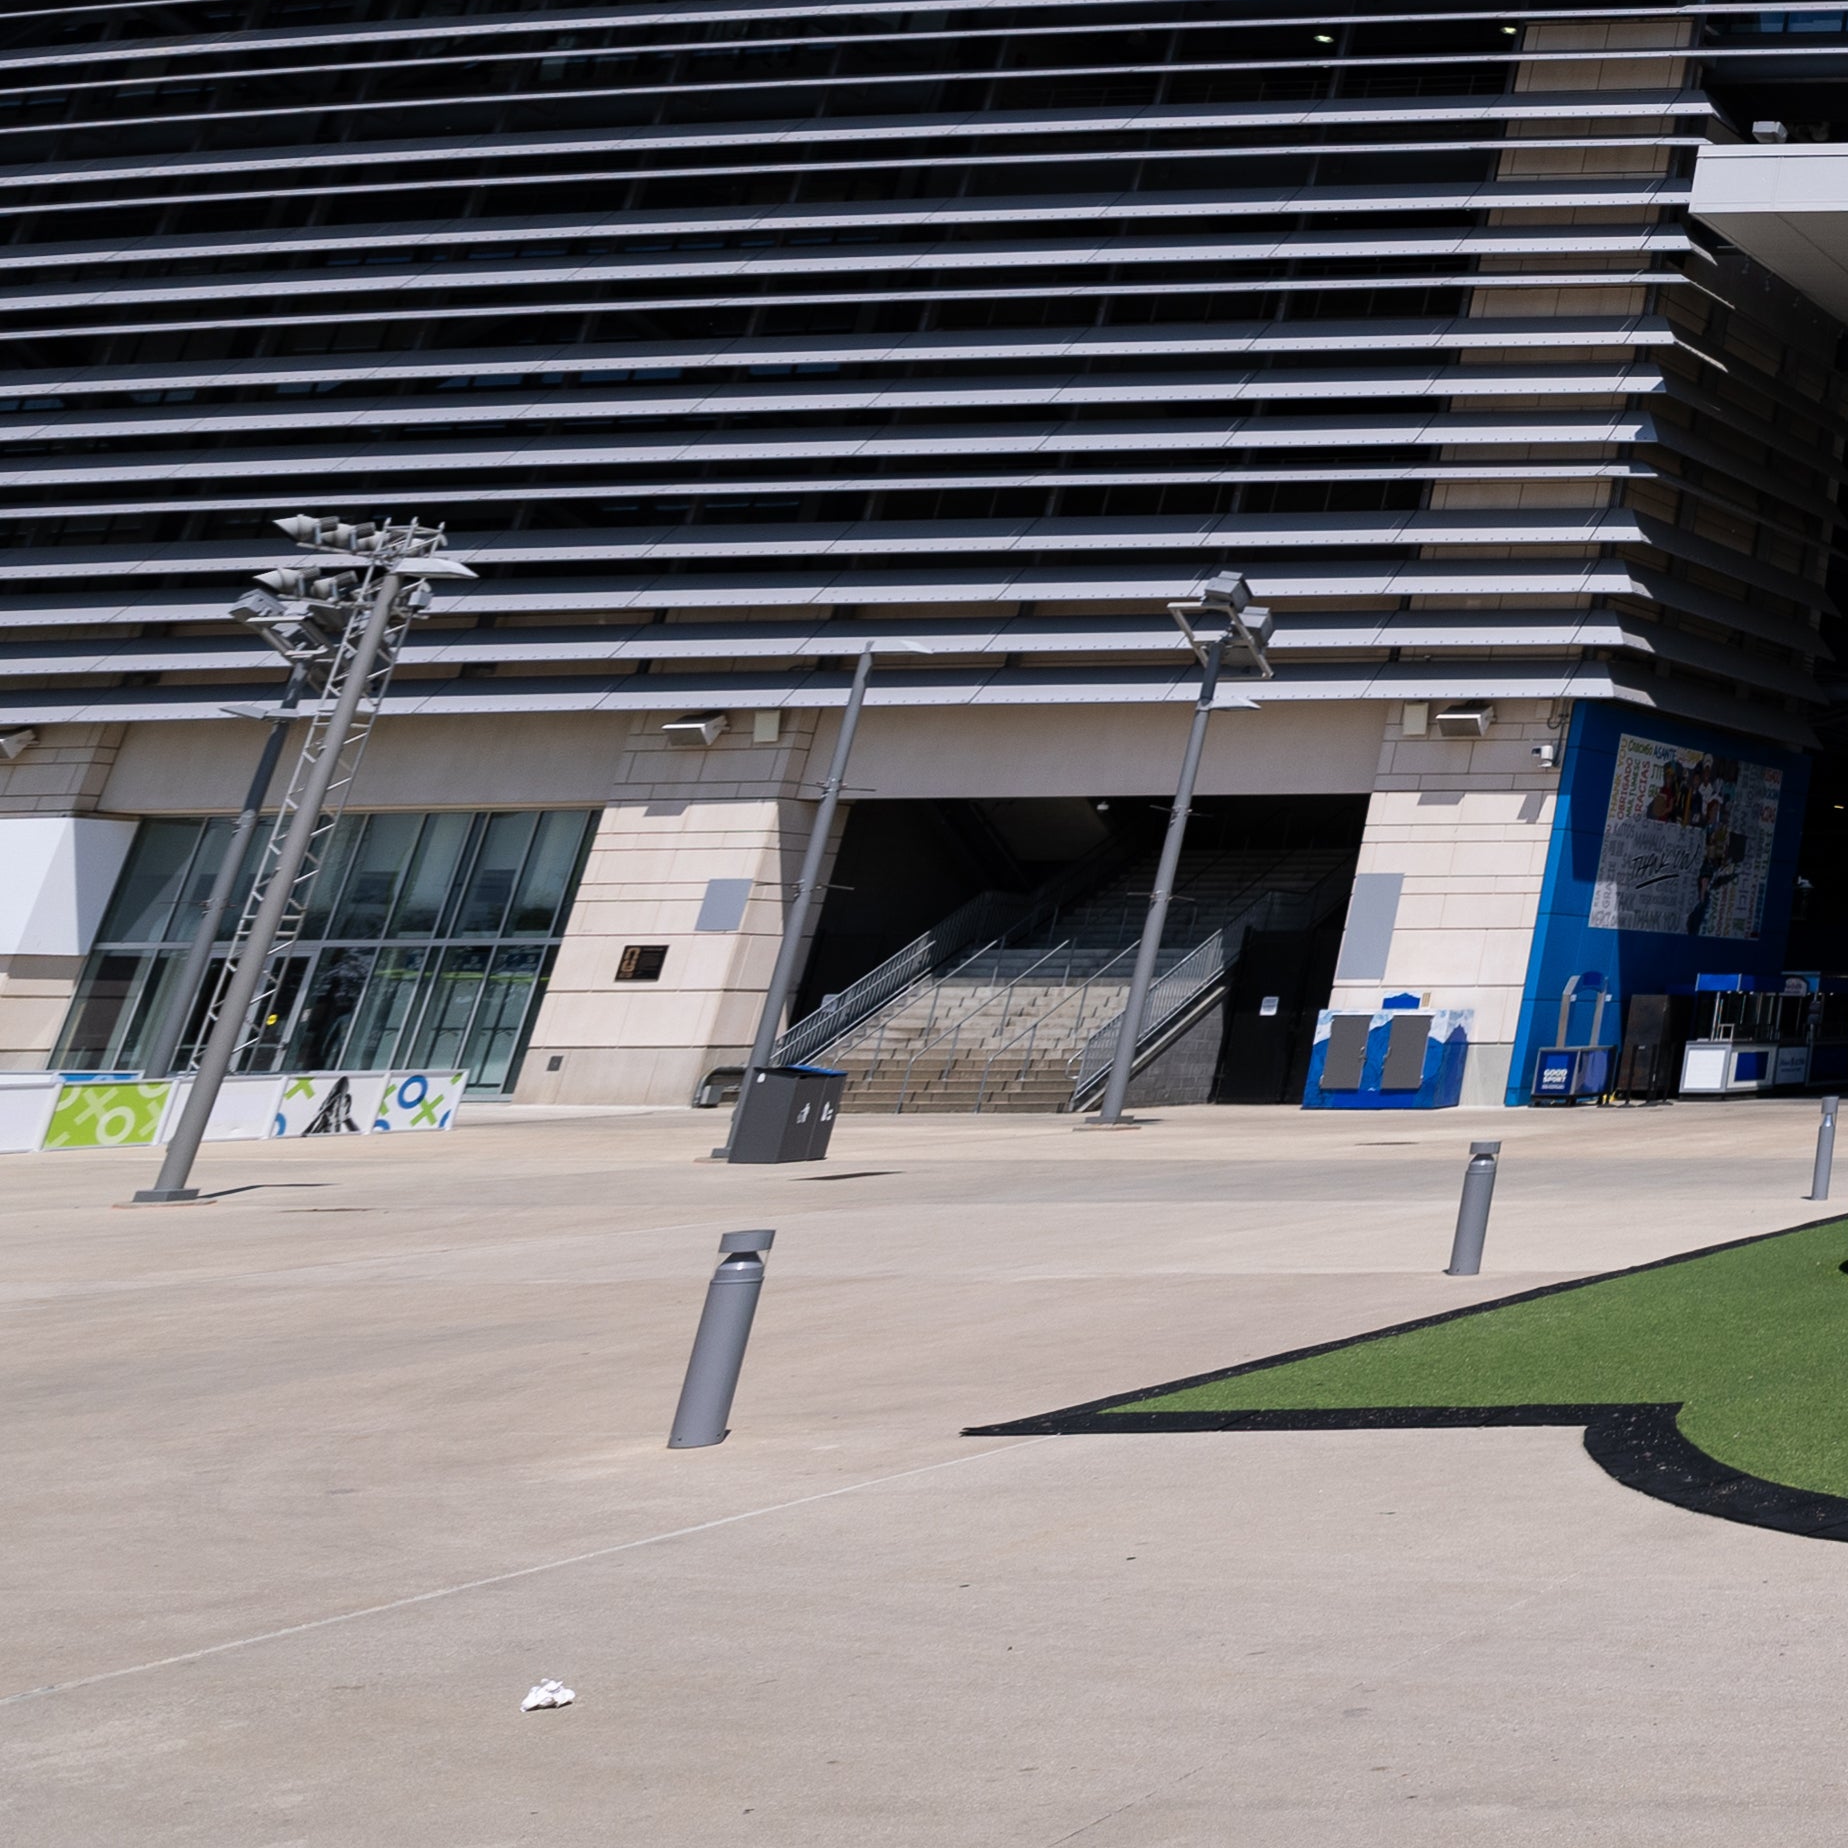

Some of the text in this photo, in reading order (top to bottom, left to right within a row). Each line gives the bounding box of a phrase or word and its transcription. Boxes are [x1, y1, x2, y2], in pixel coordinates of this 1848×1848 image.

[1616, 756, 1633, 820] OBRIGADO
[1633, 759, 1650, 822] GRACIAS
[1543, 1068, 1568, 1077] GOOD
